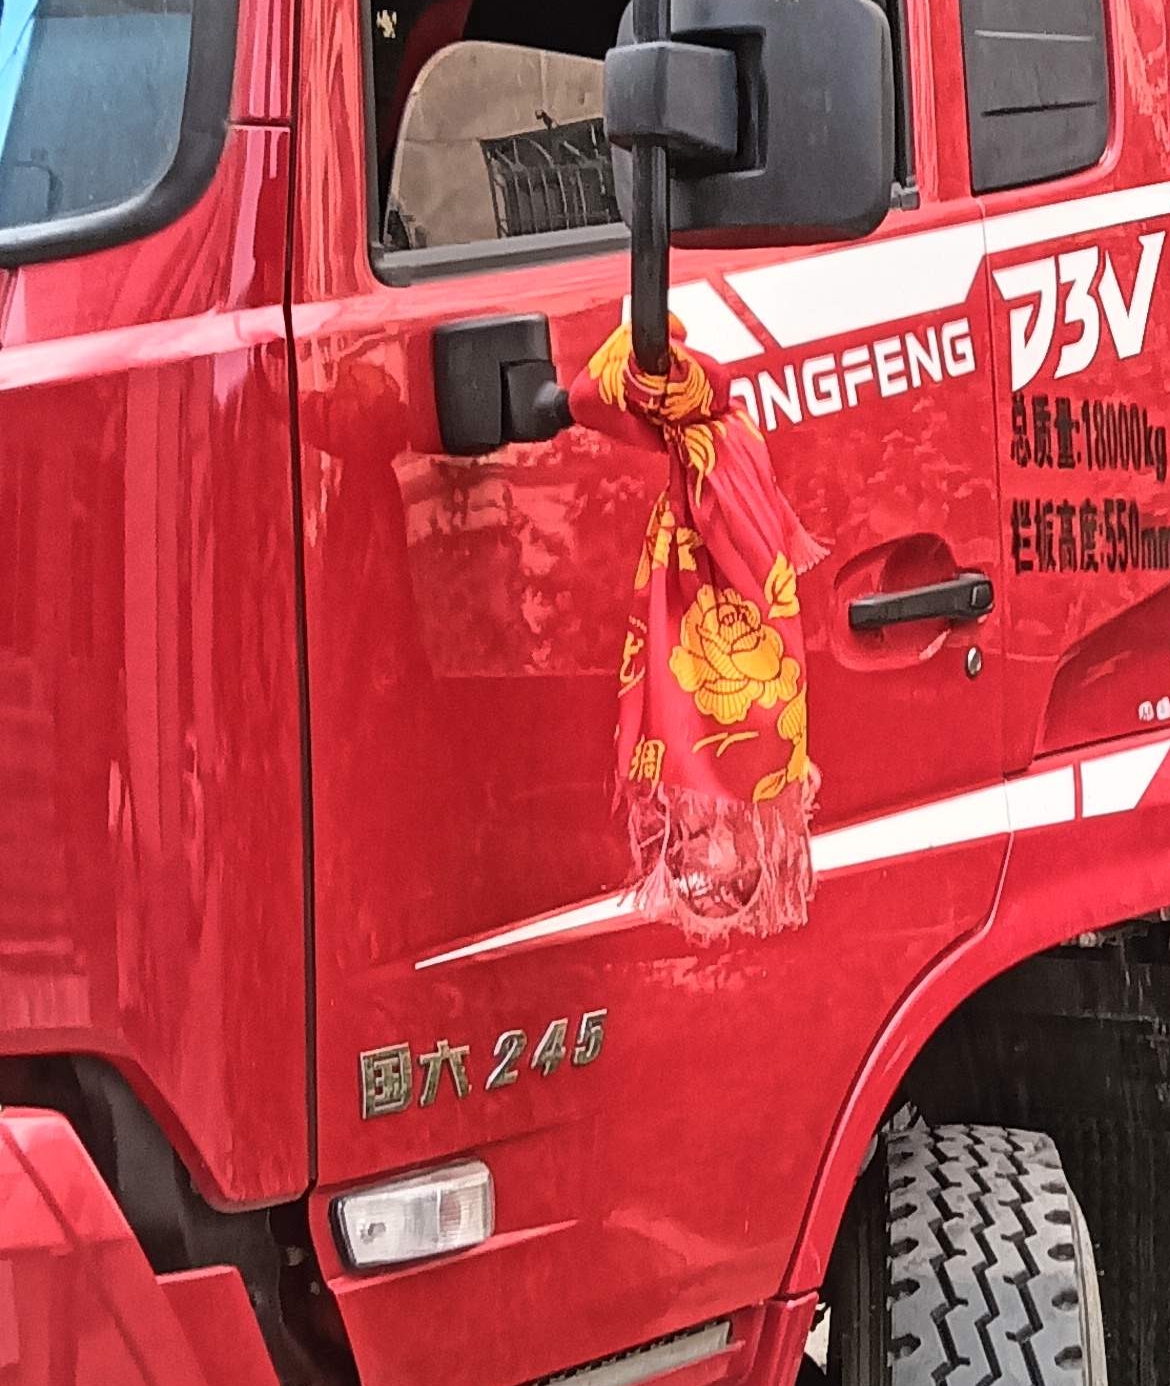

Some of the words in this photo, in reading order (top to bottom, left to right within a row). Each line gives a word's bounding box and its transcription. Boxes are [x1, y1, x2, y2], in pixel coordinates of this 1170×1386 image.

[991, 230, 1167, 392] D3V
[729, 317, 975, 432] ONGFENG
[1010, 391, 1169, 482] 总质量:18000kg
[359, 1039, 473, 1120] 国六
[485, 1008, 609, 1091] 245
